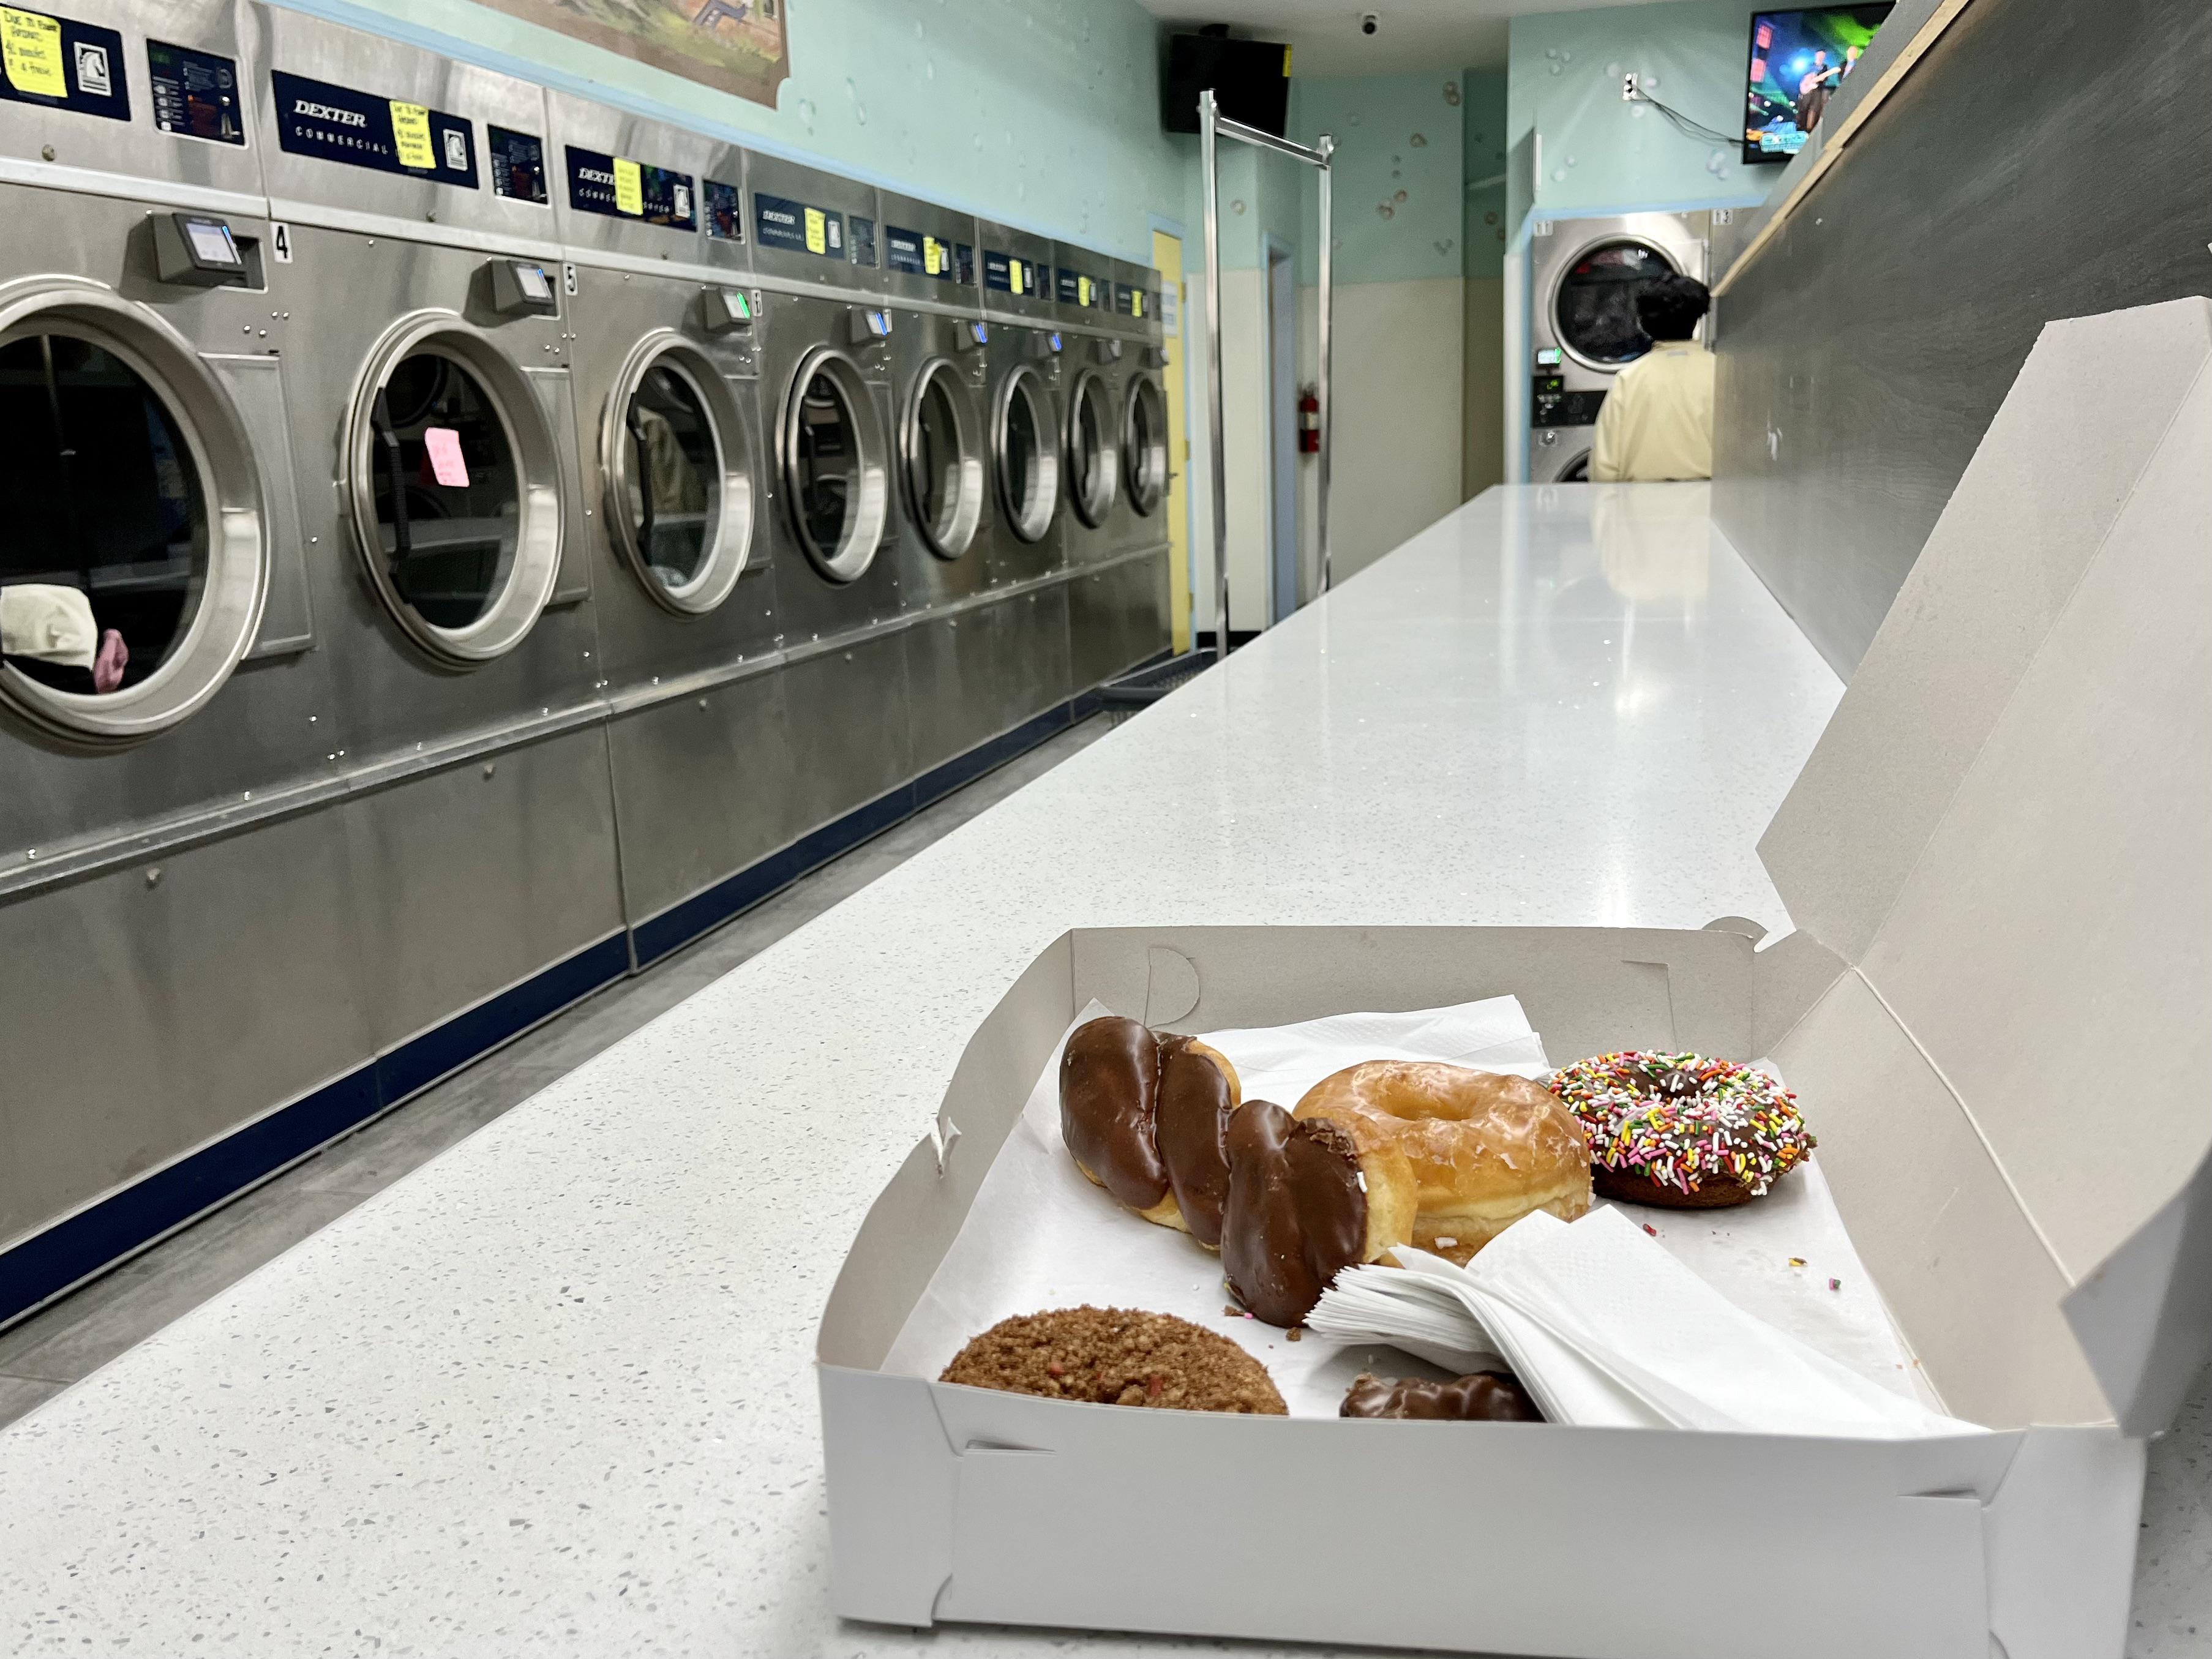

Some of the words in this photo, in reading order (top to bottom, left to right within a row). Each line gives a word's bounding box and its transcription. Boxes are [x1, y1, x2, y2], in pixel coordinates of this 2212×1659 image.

[293, 99, 367, 128] DEXTER
[295, 125, 388, 155] COMMERCIAL
[277, 225, 288, 258] 4
